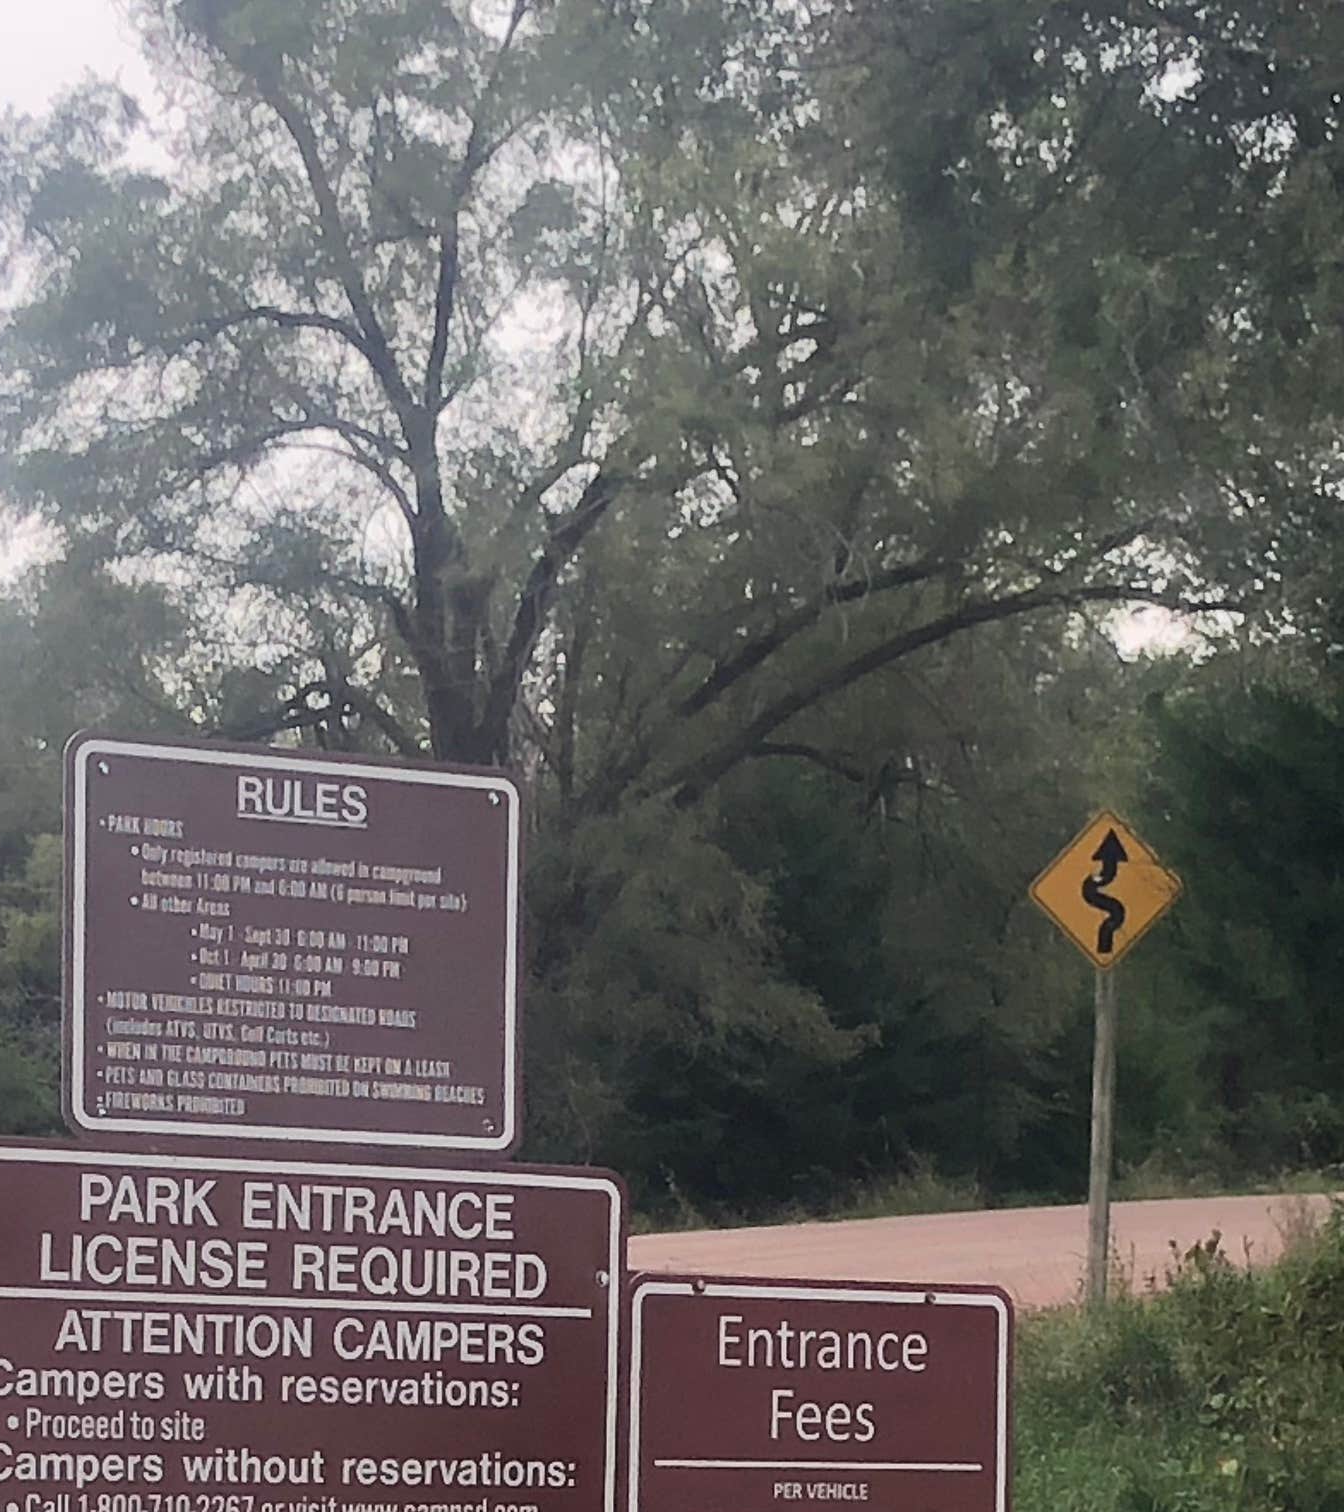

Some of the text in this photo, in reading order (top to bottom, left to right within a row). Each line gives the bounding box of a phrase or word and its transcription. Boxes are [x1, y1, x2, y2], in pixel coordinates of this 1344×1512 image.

[237, 775, 368, 823] RULES
[108, 814, 184, 838] PARK HOURS
[142, 842, 168, 865] Only
[170, 848, 232, 868] registered
[236, 853, 286, 874] campers
[311, 858, 355, 878] allowed
[372, 866, 441, 885] campground
[142, 868, 192, 889] between
[197, 873, 230, 892] 11:00
[233, 876, 251, 893] PM
[254, 879, 275, 896] and
[309, 882, 327, 899] AM
[142, 893, 230, 916] All other Areas
[199, 923, 224, 944] May
[244, 926, 272, 946] Sept
[275, 928, 291, 946] 30
[328, 932, 346, 950] AM
[357, 935, 388, 953] 11:00
[391, 936, 409, 954] PM
[199, 947, 219, 965] Oct
[240, 950, 268, 971] April
[272, 952, 287, 970] 30
[325, 956, 343, 974] AM
[382, 960, 401, 979] PM
[199, 972, 332, 997] QUIET HOURS 11:00 PM
[107, 991, 148, 1011] MOTOR
[217, 998, 285, 1020] RESTRICTED
[289, 1002, 304, 1020] TO
[307, 1004, 376, 1026] DESIGNATED
[379, 1009, 416, 1028] ROADS
[107, 1041, 450, 1078] WHEN IN THE CAMPGROUND PETS MUST BE KEPT ON A LEASH
[106, 1065, 486, 1105] PETS AND GLASS CONTAINERS PROHIBITED ON SWIMMING BEACHES
[106, 1091, 245, 1115] FIREWORKS PROHIBITED
[80, 1173, 515, 1240] PARK ENTRANCE
[40, 1233, 547, 1300] LICENSE REQUIRED
[54, 1309, 545, 1366] ATTENTION CAMPERS
[718, 1315, 928, 1372] Entrance
[184, 1364, 263, 1401] with
[281, 1370, 521, 1407] reservations:
[25, 1407, 205, 1441] Proceed to site
[770, 1389, 876, 1442] Fees
[182, 1448, 325, 1484] without
[342, 1452, 577, 1487] reservations:
[774, 1483, 868, 1501] PER VEHICLE
